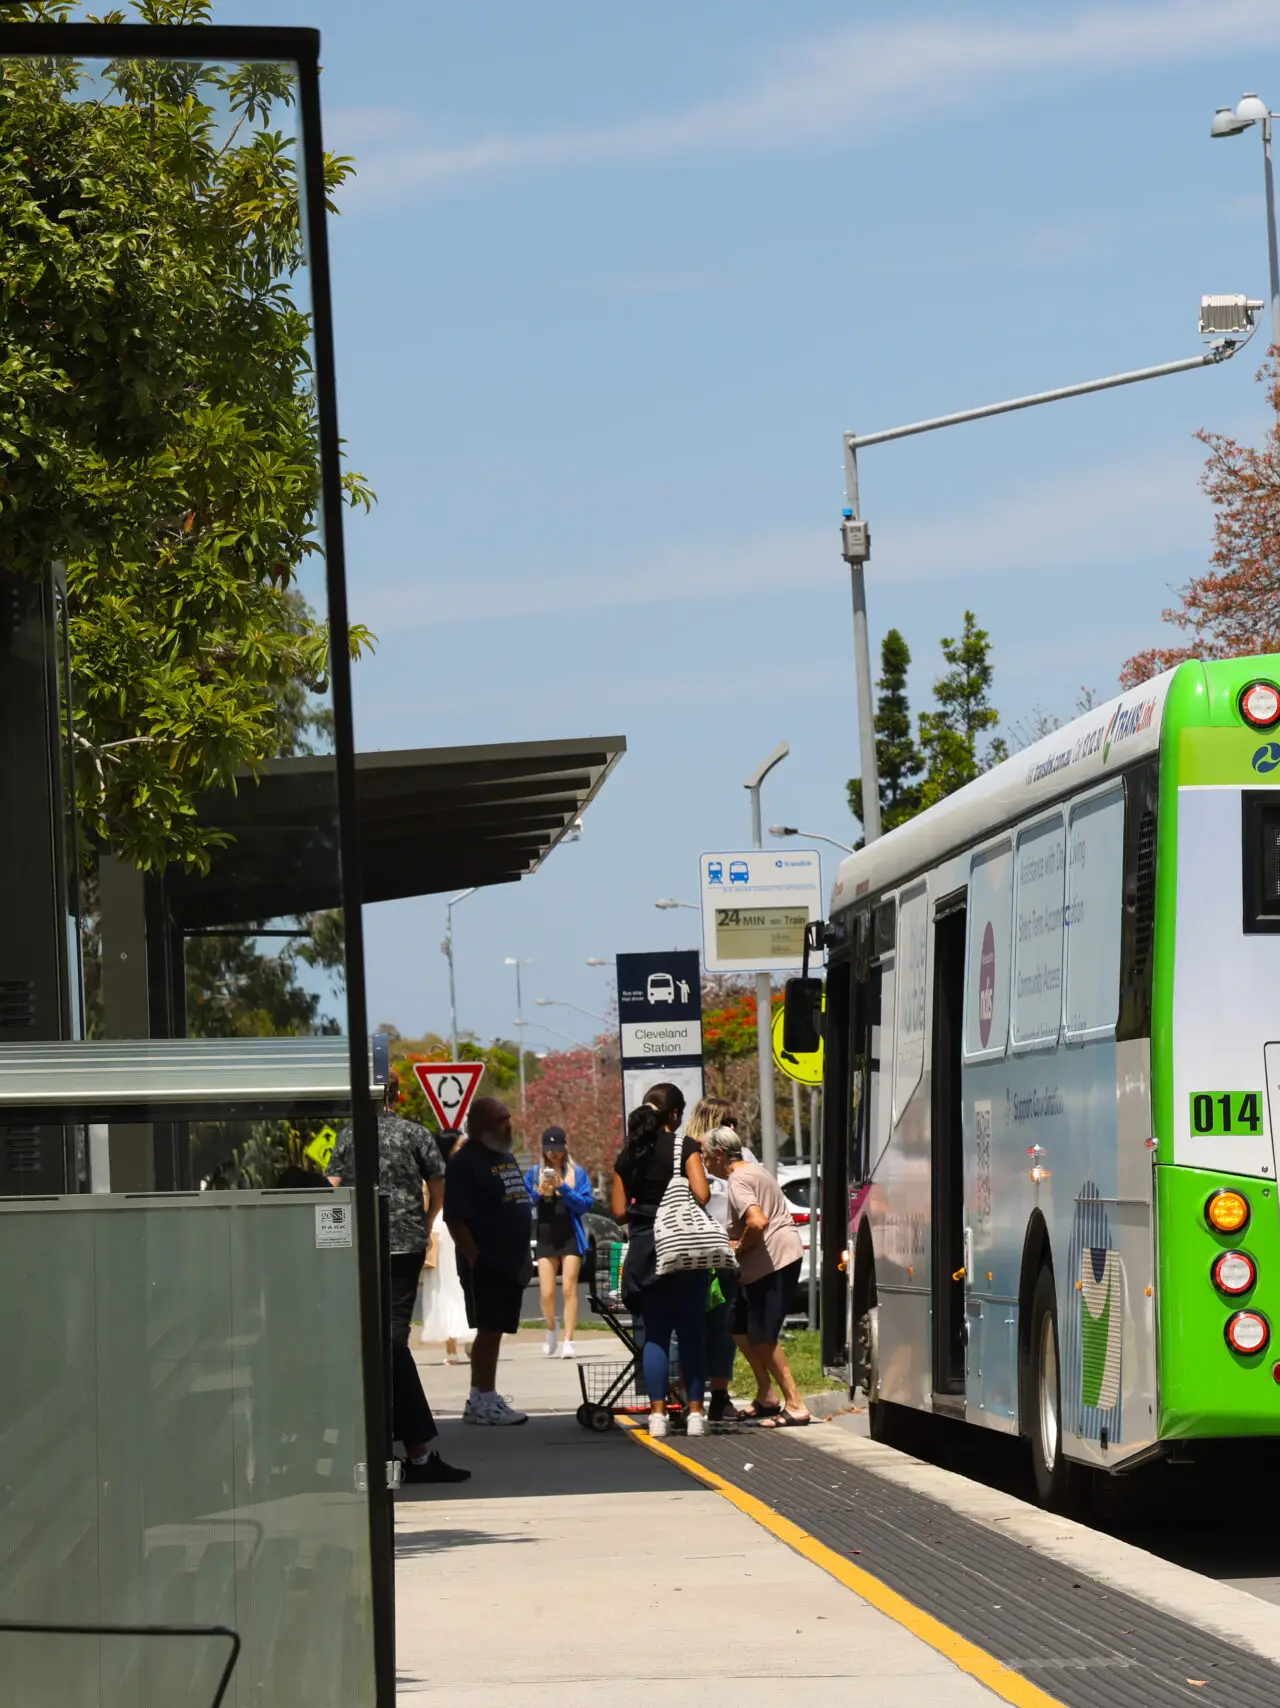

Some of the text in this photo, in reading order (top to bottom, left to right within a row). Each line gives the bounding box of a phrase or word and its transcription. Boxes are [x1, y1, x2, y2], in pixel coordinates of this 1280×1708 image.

[718, 909, 741, 927] 24
[743, 915, 766, 926] MIN
[784, 914, 806, 924] Train
[634, 1028, 688, 1040] Cleveland
[642, 1042, 682, 1054] Station
[1194, 1094, 1260, 1132] 014
